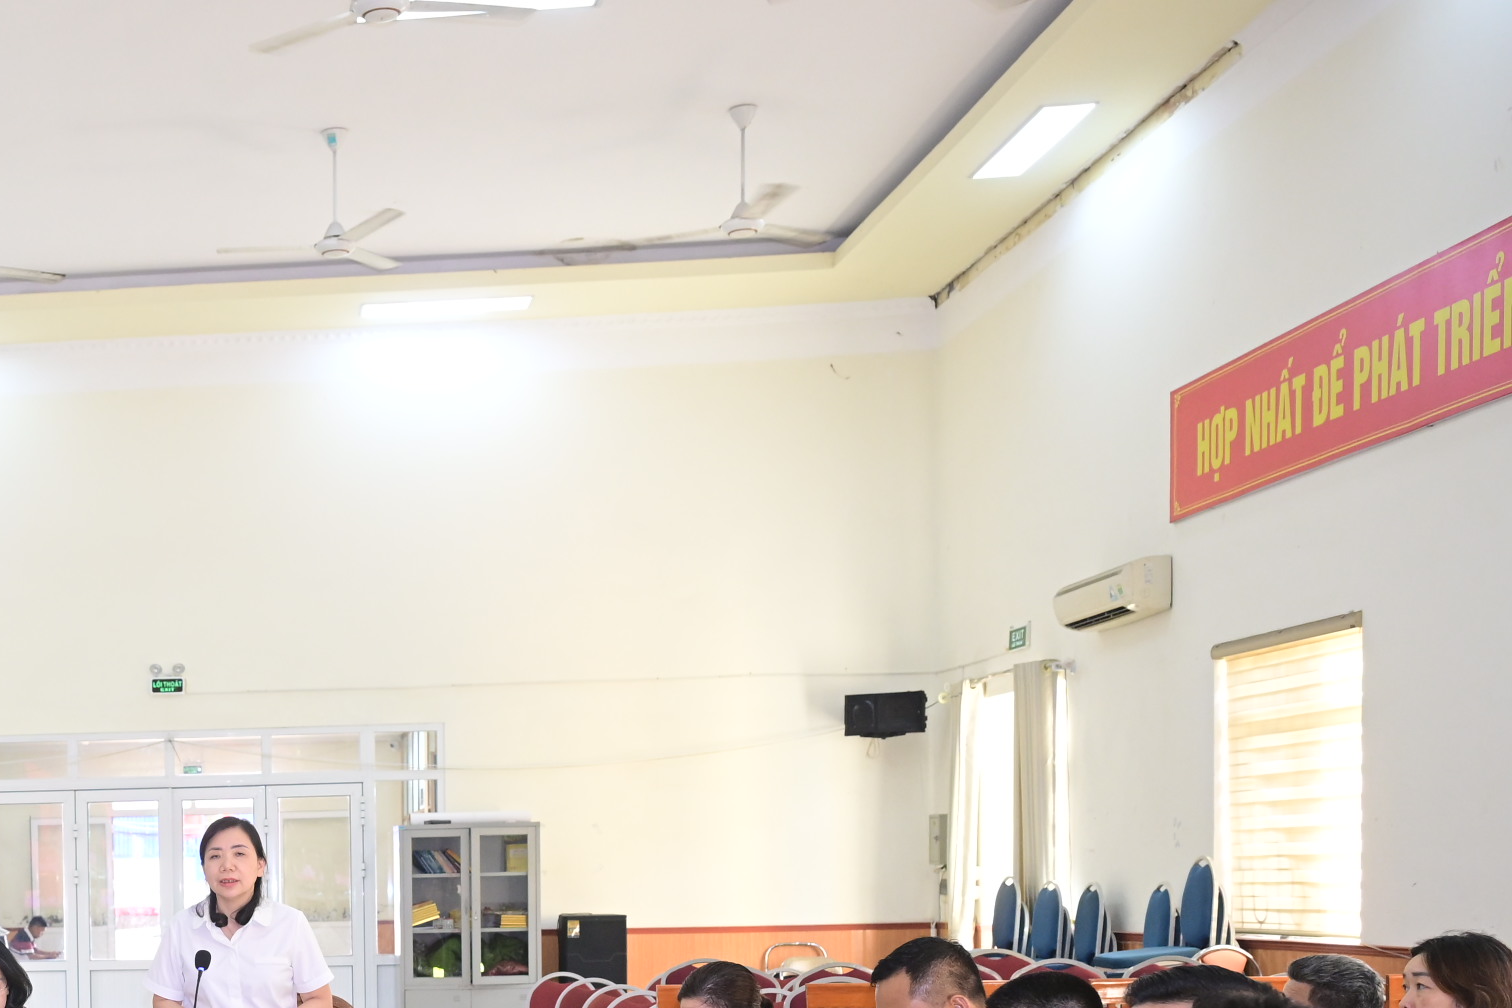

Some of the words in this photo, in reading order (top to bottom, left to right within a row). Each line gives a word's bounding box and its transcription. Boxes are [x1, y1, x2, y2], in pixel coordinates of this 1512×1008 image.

[1197, 404, 1239, 482] HỢP
[1245, 356, 1306, 456] NHẤT
[1312, 328, 1347, 428] ĐỂ
[1353, 312, 1425, 411] PHÁT
